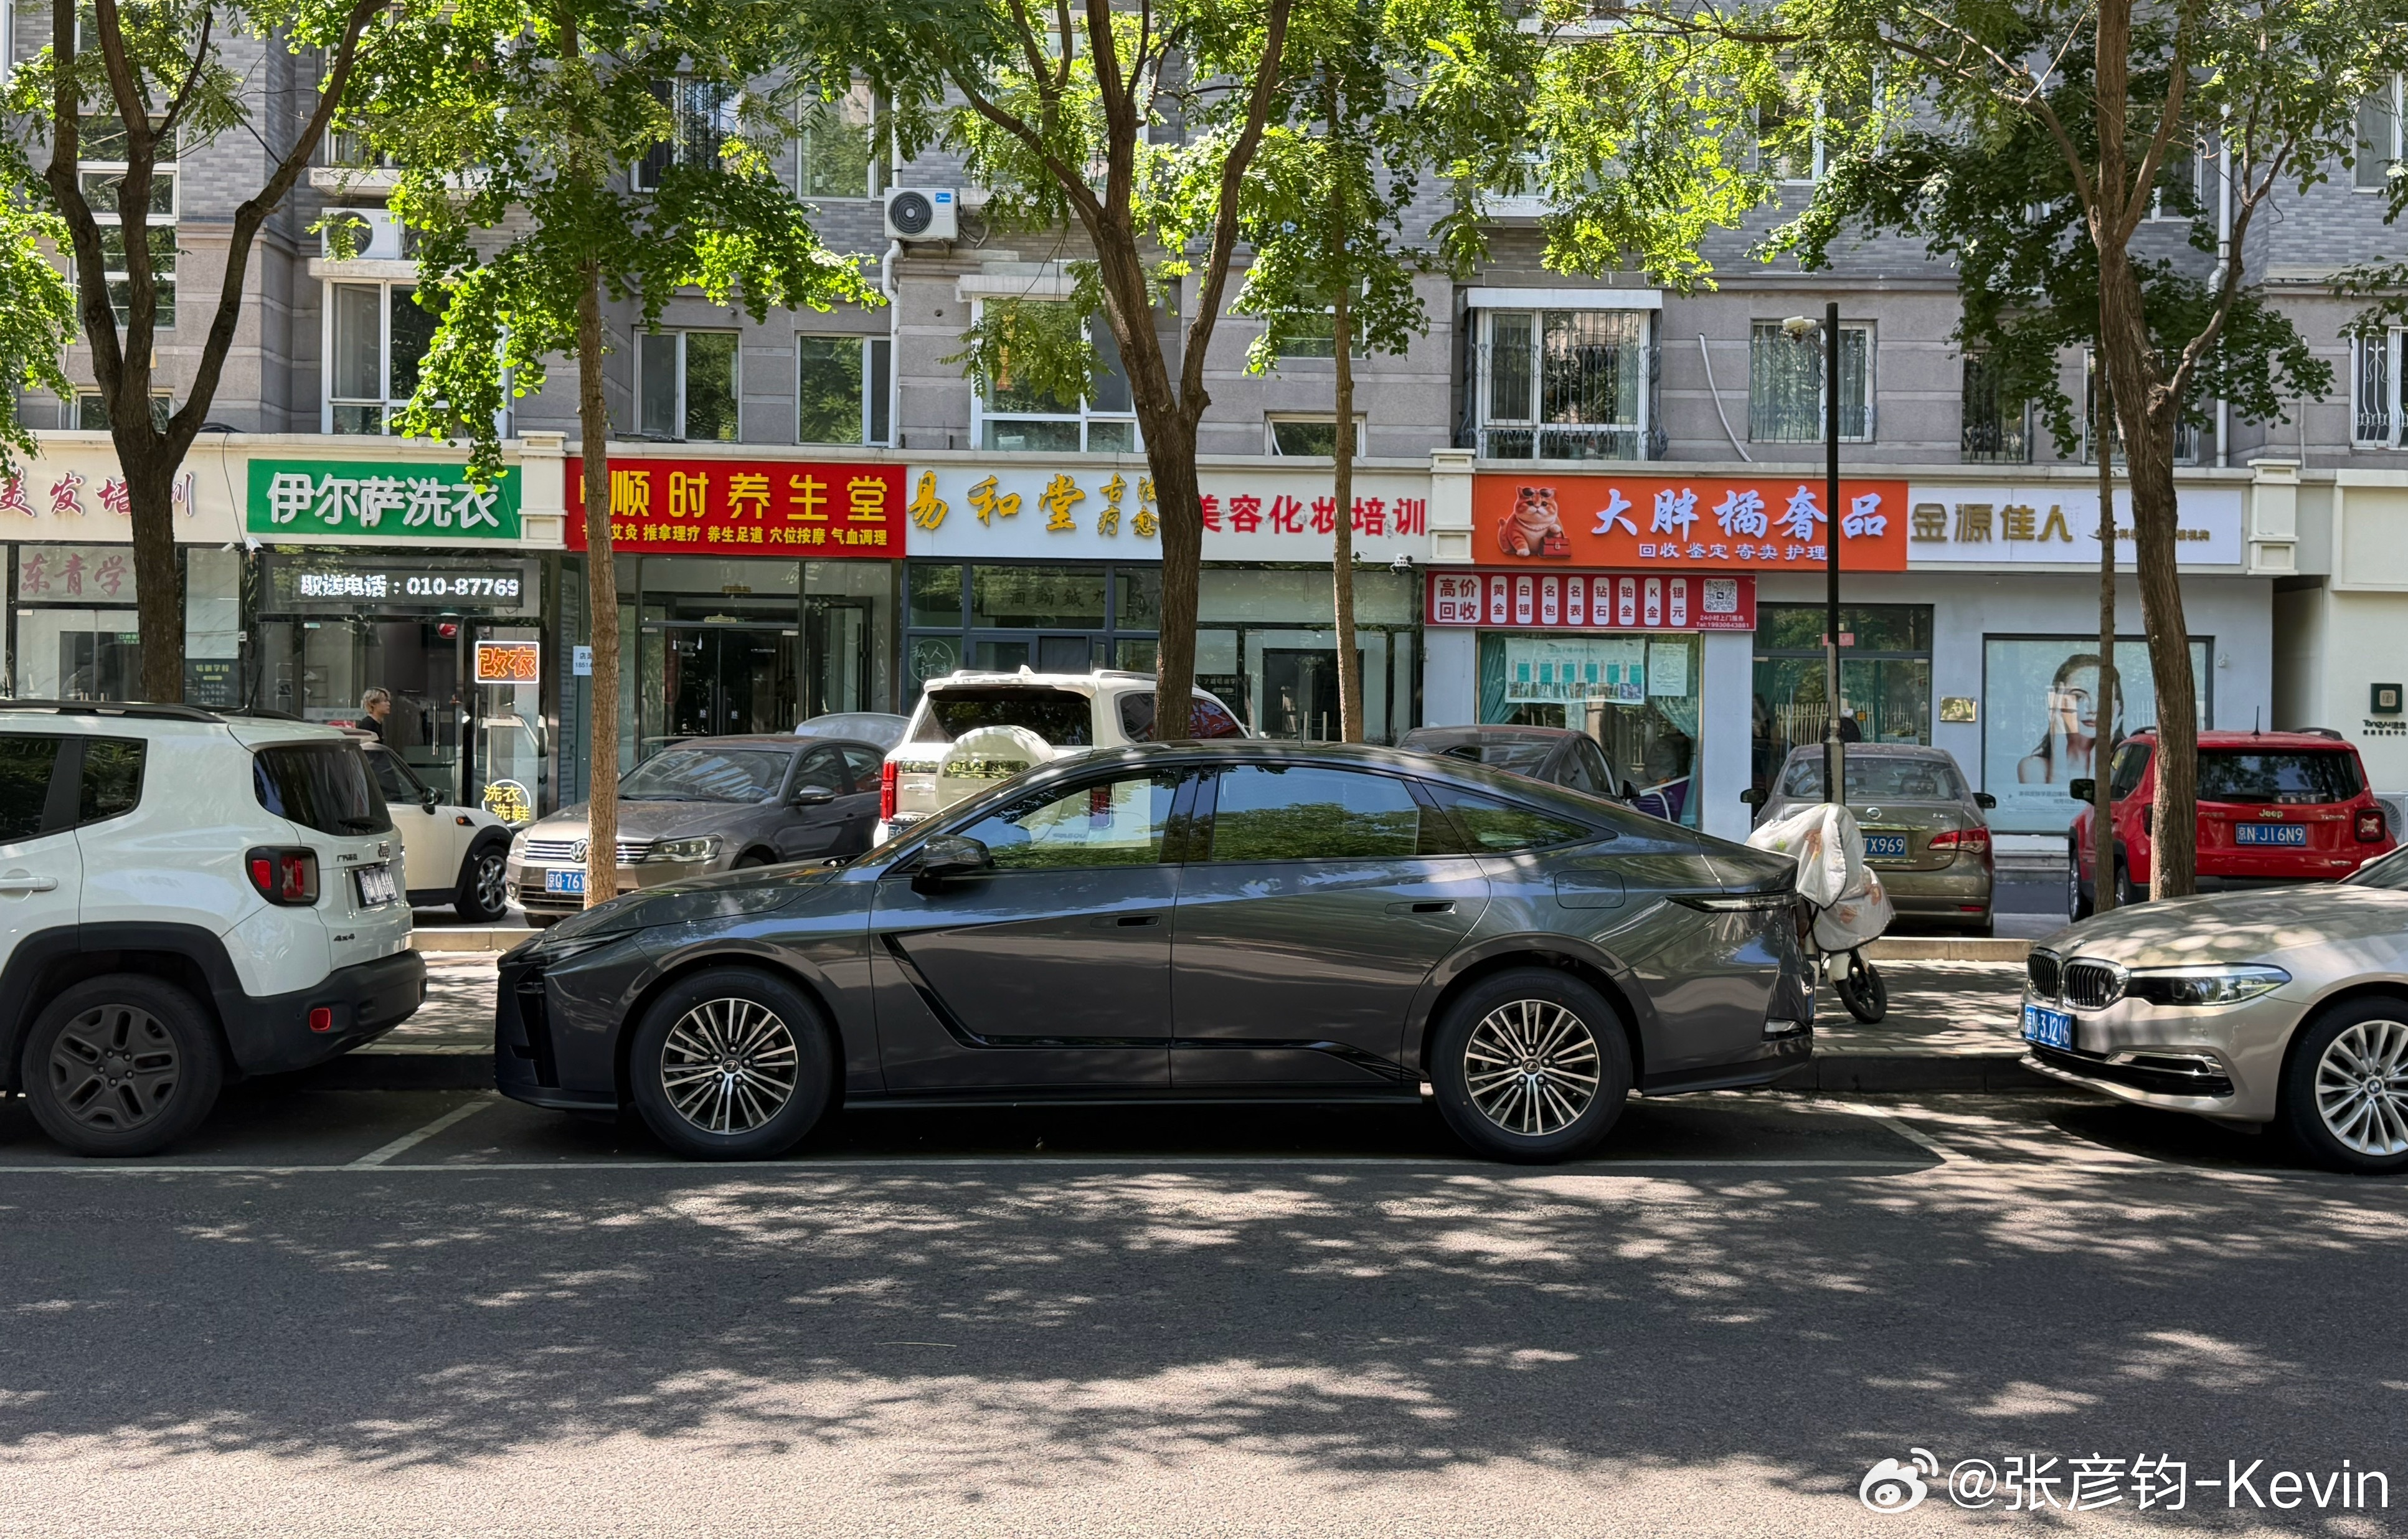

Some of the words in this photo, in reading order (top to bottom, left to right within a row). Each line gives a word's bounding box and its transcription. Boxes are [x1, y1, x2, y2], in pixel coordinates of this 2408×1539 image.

[267, 471, 499, 529] 伊尔萨洗衣
[580, 471, 887, 521] 顺时养生堂
[908, 470, 1085, 531] 易和堂
[1097, 504, 1159, 537] 疗愈
[1199, 494, 1426, 537] 美容化妆培训
[1591, 485, 1887, 542] 大胖橘奢品
[1910, 503, 2074, 542] 金源佳人
[643, 524, 700, 541] 推拿理疗
[707, 525, 763, 543] 养生足道
[769, 527, 826, 545] 穴位按摩
[831, 528, 887, 546] 气血调理
[1638, 543, 1680, 558] 回收
[1685, 543, 1729, 559] 鉴定
[1735, 544, 1778, 561] 寄卖
[1784, 545, 1828, 561] 护理
[1439, 579, 1477, 598] 高价
[1493, 584, 1505, 615] 黄金
[1518, 585, 1531, 615] 白银
[1544, 585, 1556, 616] 名包
[1570, 585, 1582, 617] 名表
[1595, 585, 1608, 617] 钻石
[1621, 586, 1633, 617] 铂金
[1646, 587, 1659, 618] K金
[1672, 587, 1684, 618] 银元
[1439, 602, 1477, 620] 回收
[478, 646, 537, 678] 改衣
[483, 785, 522, 803] 洗衣
[492, 804, 530, 822] 洗鞋
[2259, 808, 2283, 818] Jeep
